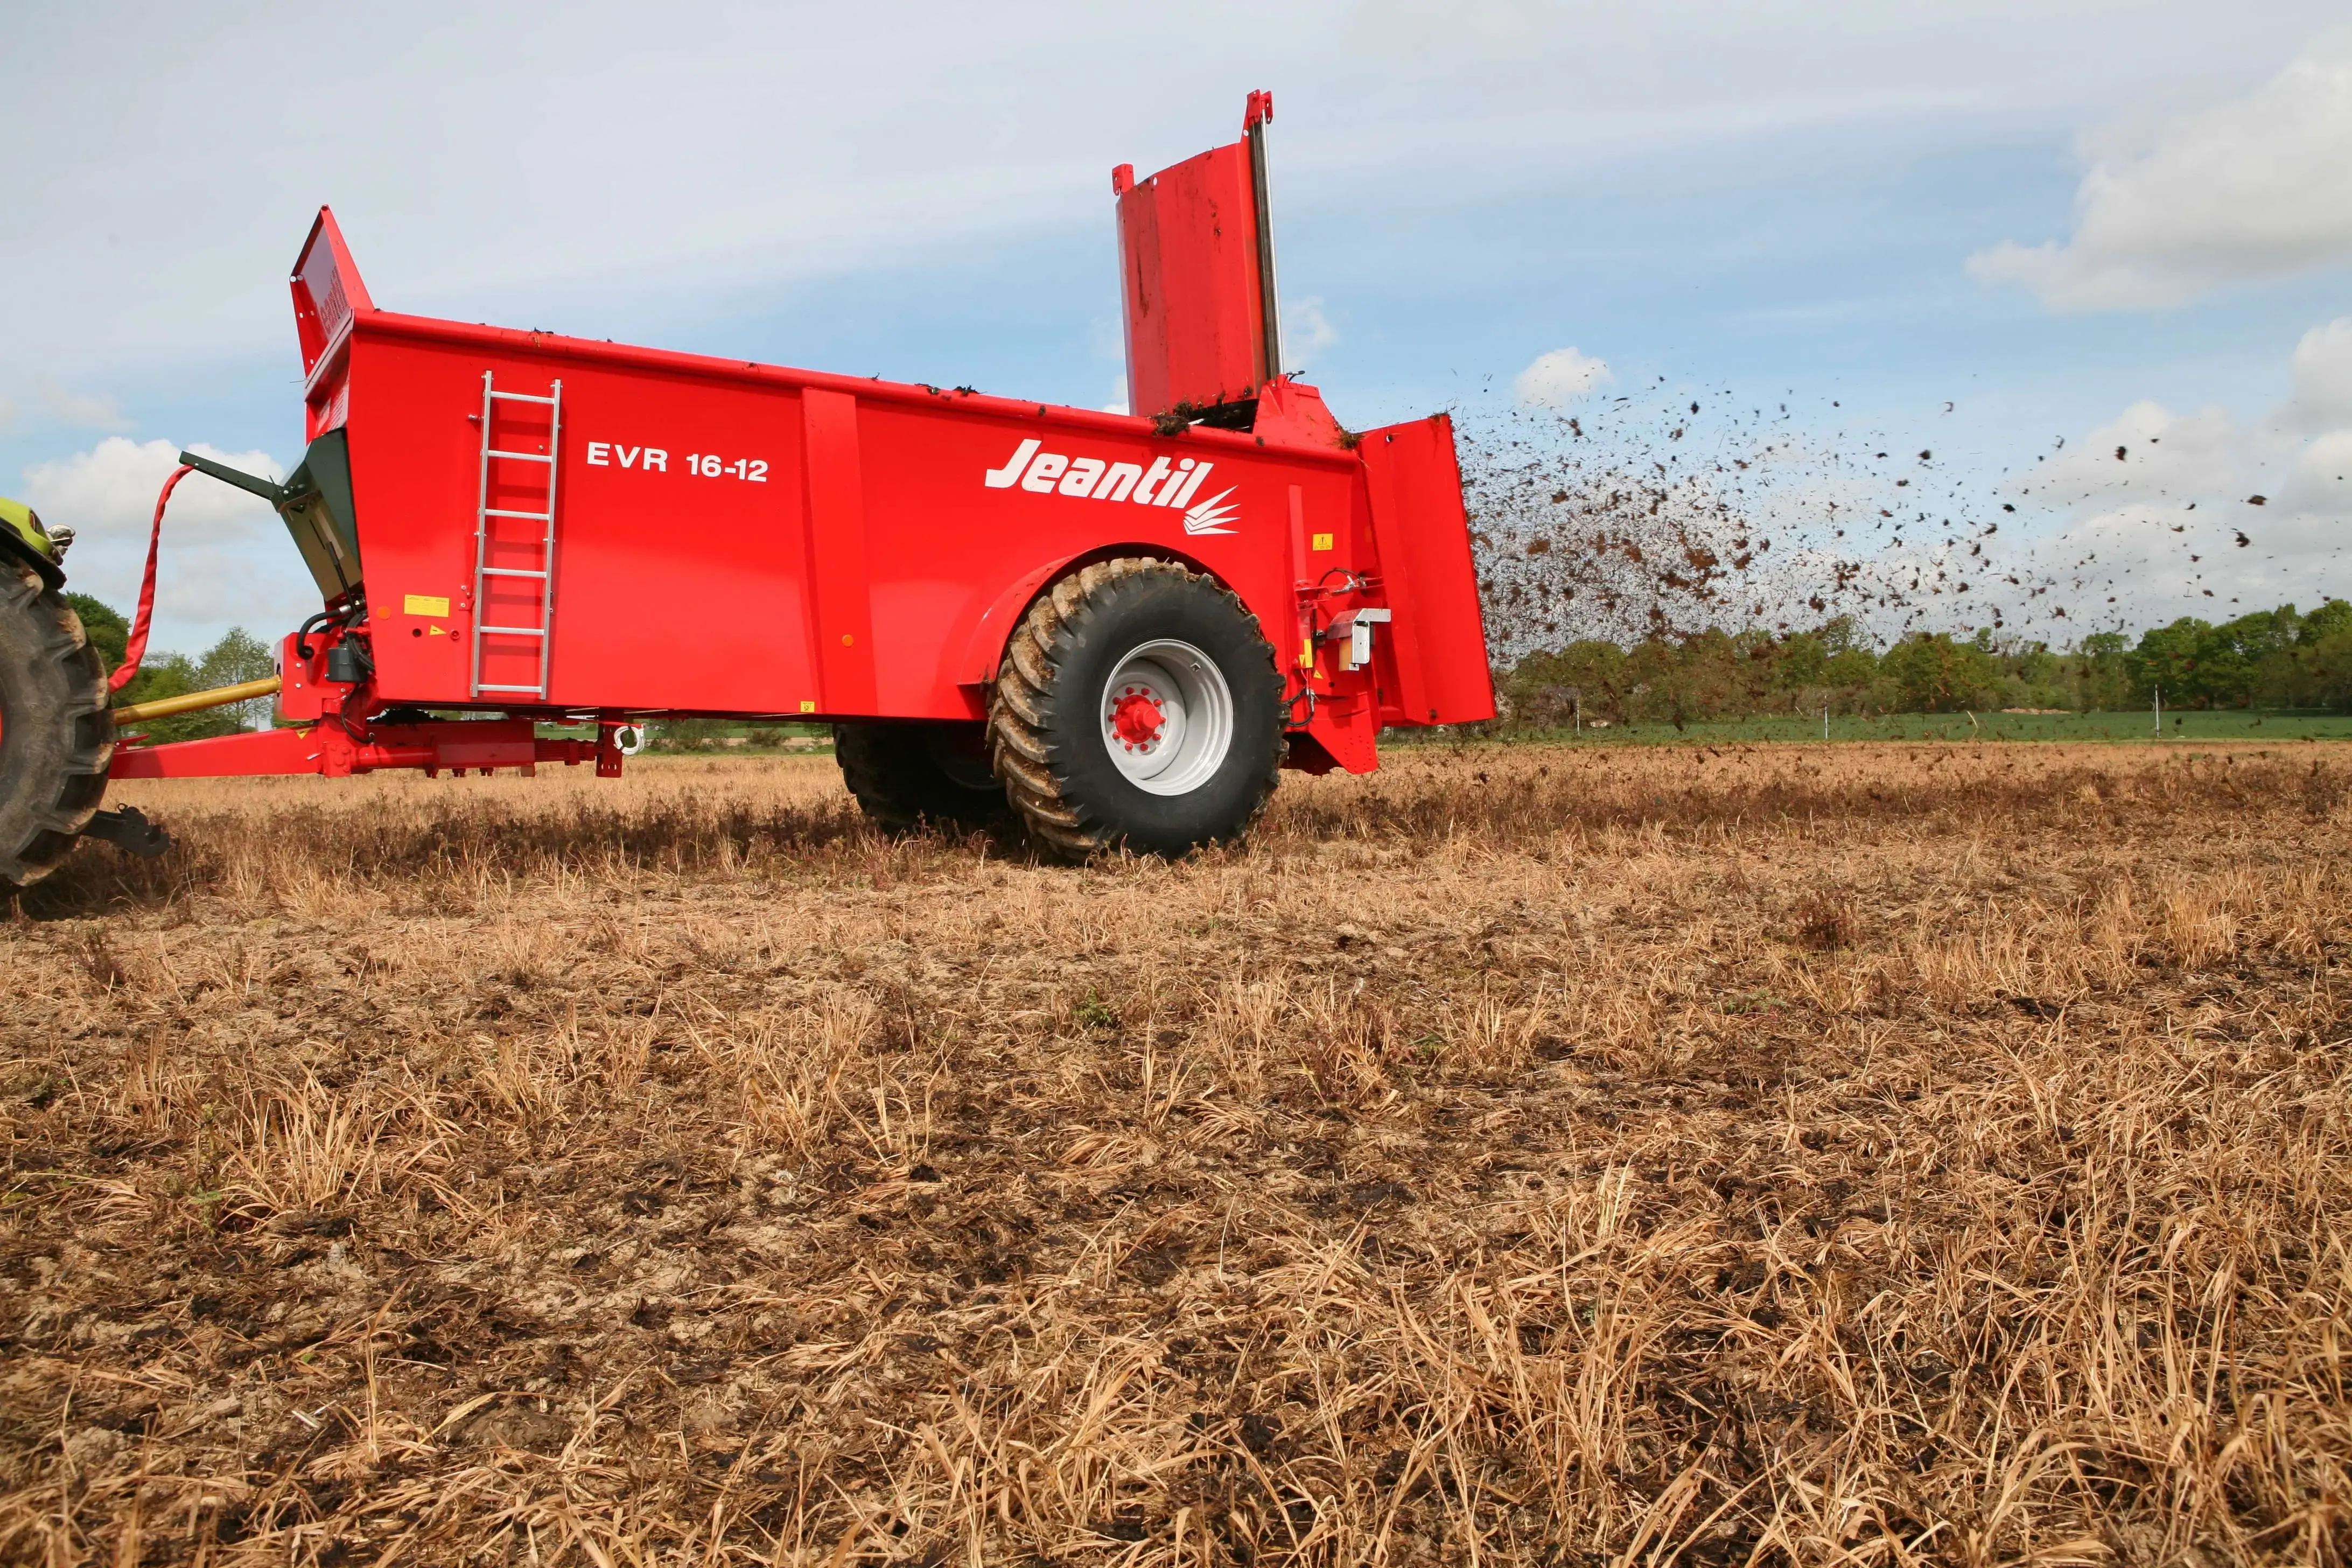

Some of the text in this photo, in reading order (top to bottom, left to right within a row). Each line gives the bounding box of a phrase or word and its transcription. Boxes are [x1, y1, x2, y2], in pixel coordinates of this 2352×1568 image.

[587, 441, 769, 482] EVR 16-12
[984, 438, 1215, 509] Jeantil
